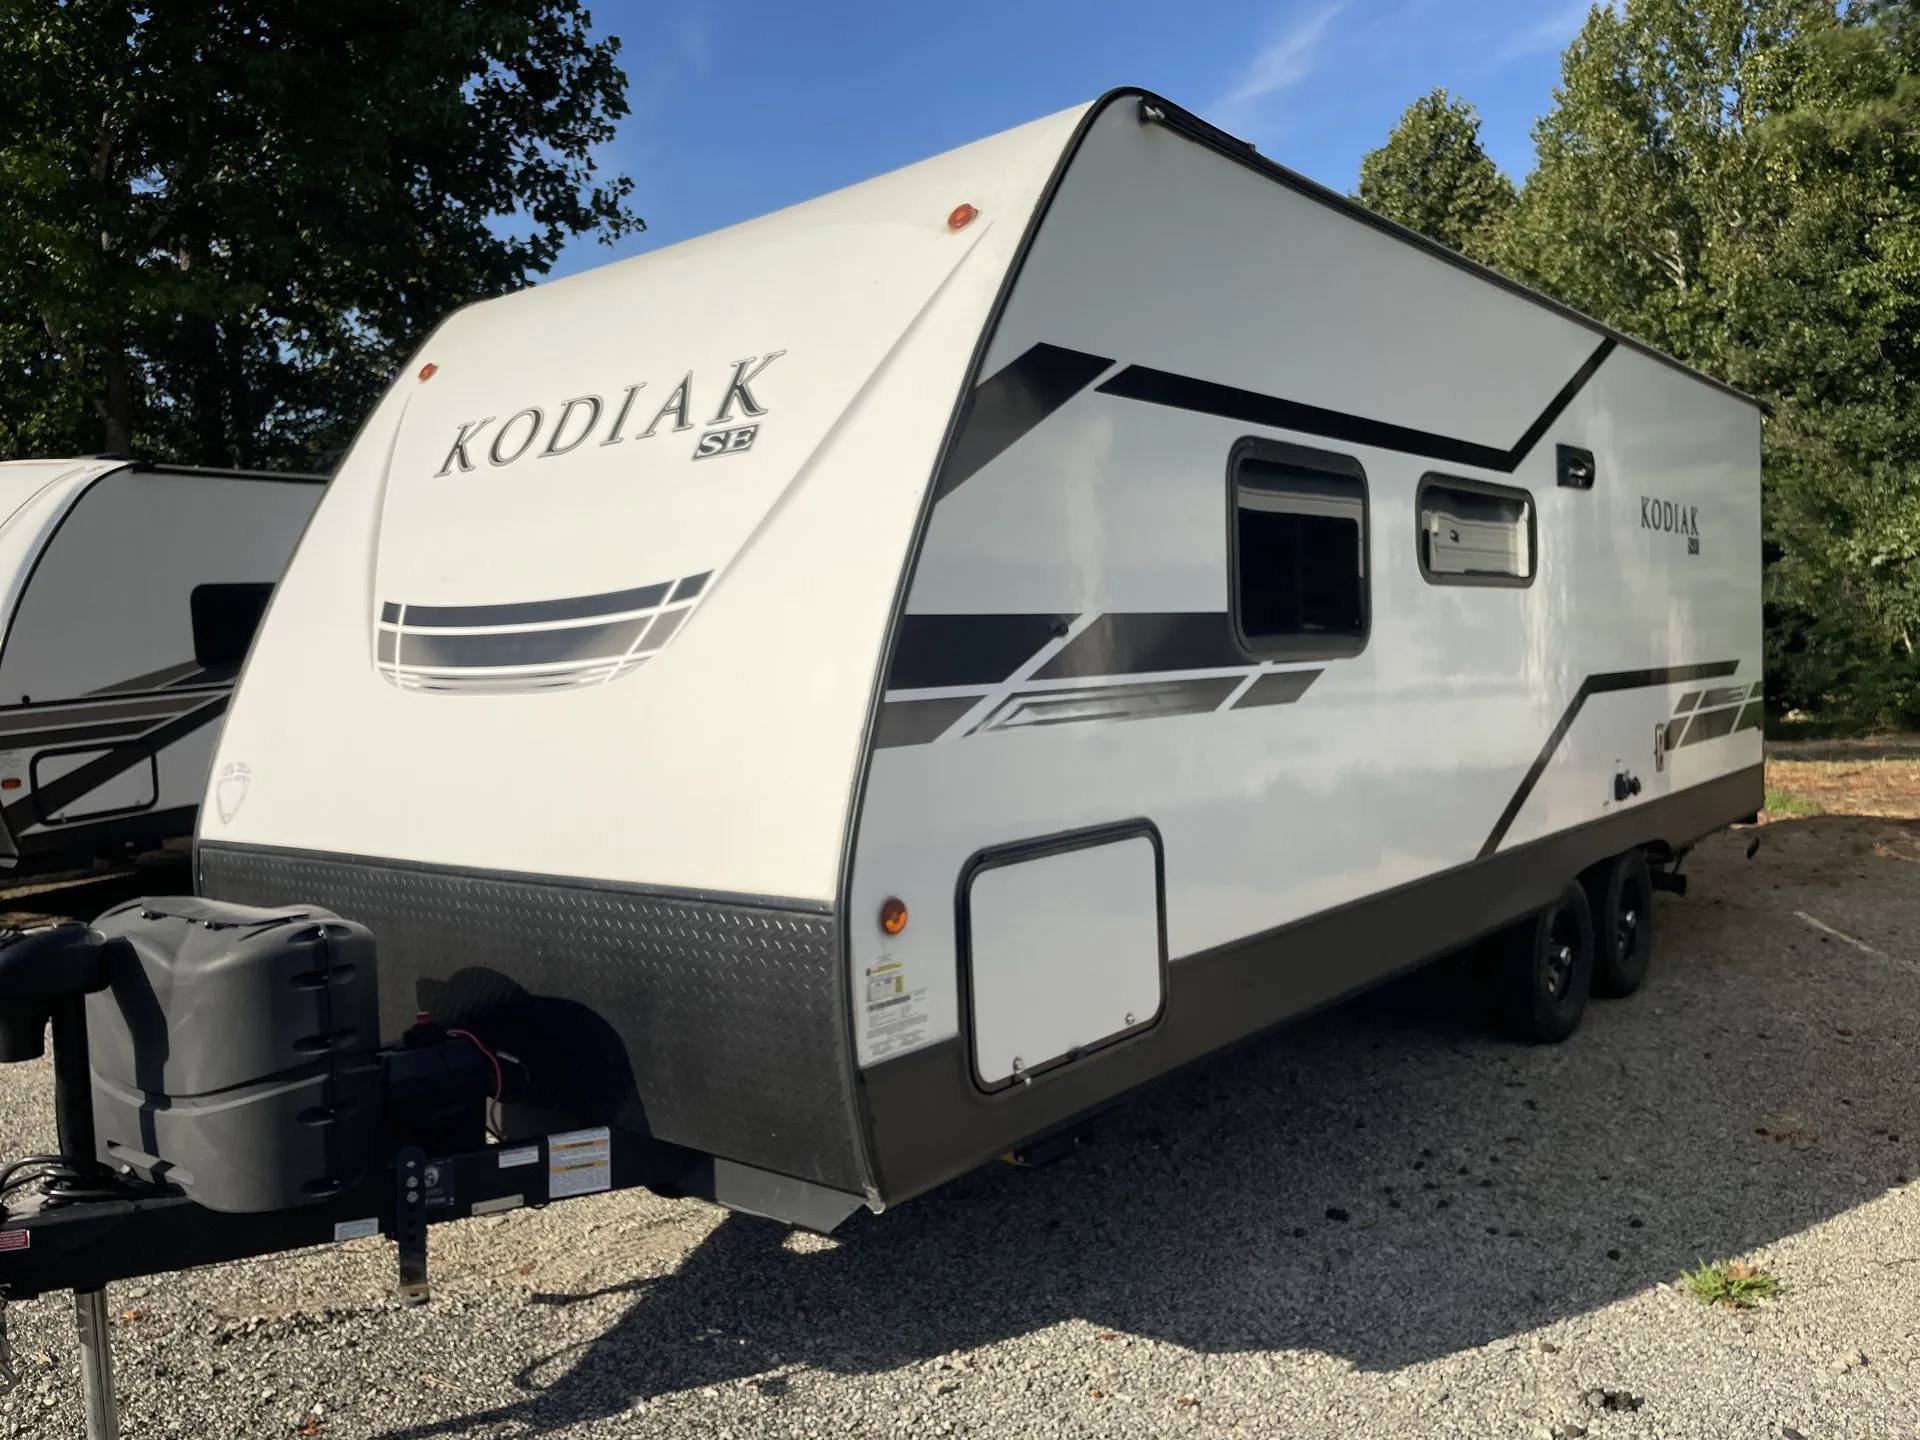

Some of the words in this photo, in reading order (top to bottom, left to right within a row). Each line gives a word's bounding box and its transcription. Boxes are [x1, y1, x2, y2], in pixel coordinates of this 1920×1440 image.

[433, 350, 787, 478] KODIAK
[695, 425, 758, 458] SE
[1640, 496, 1698, 536] KODIAK
